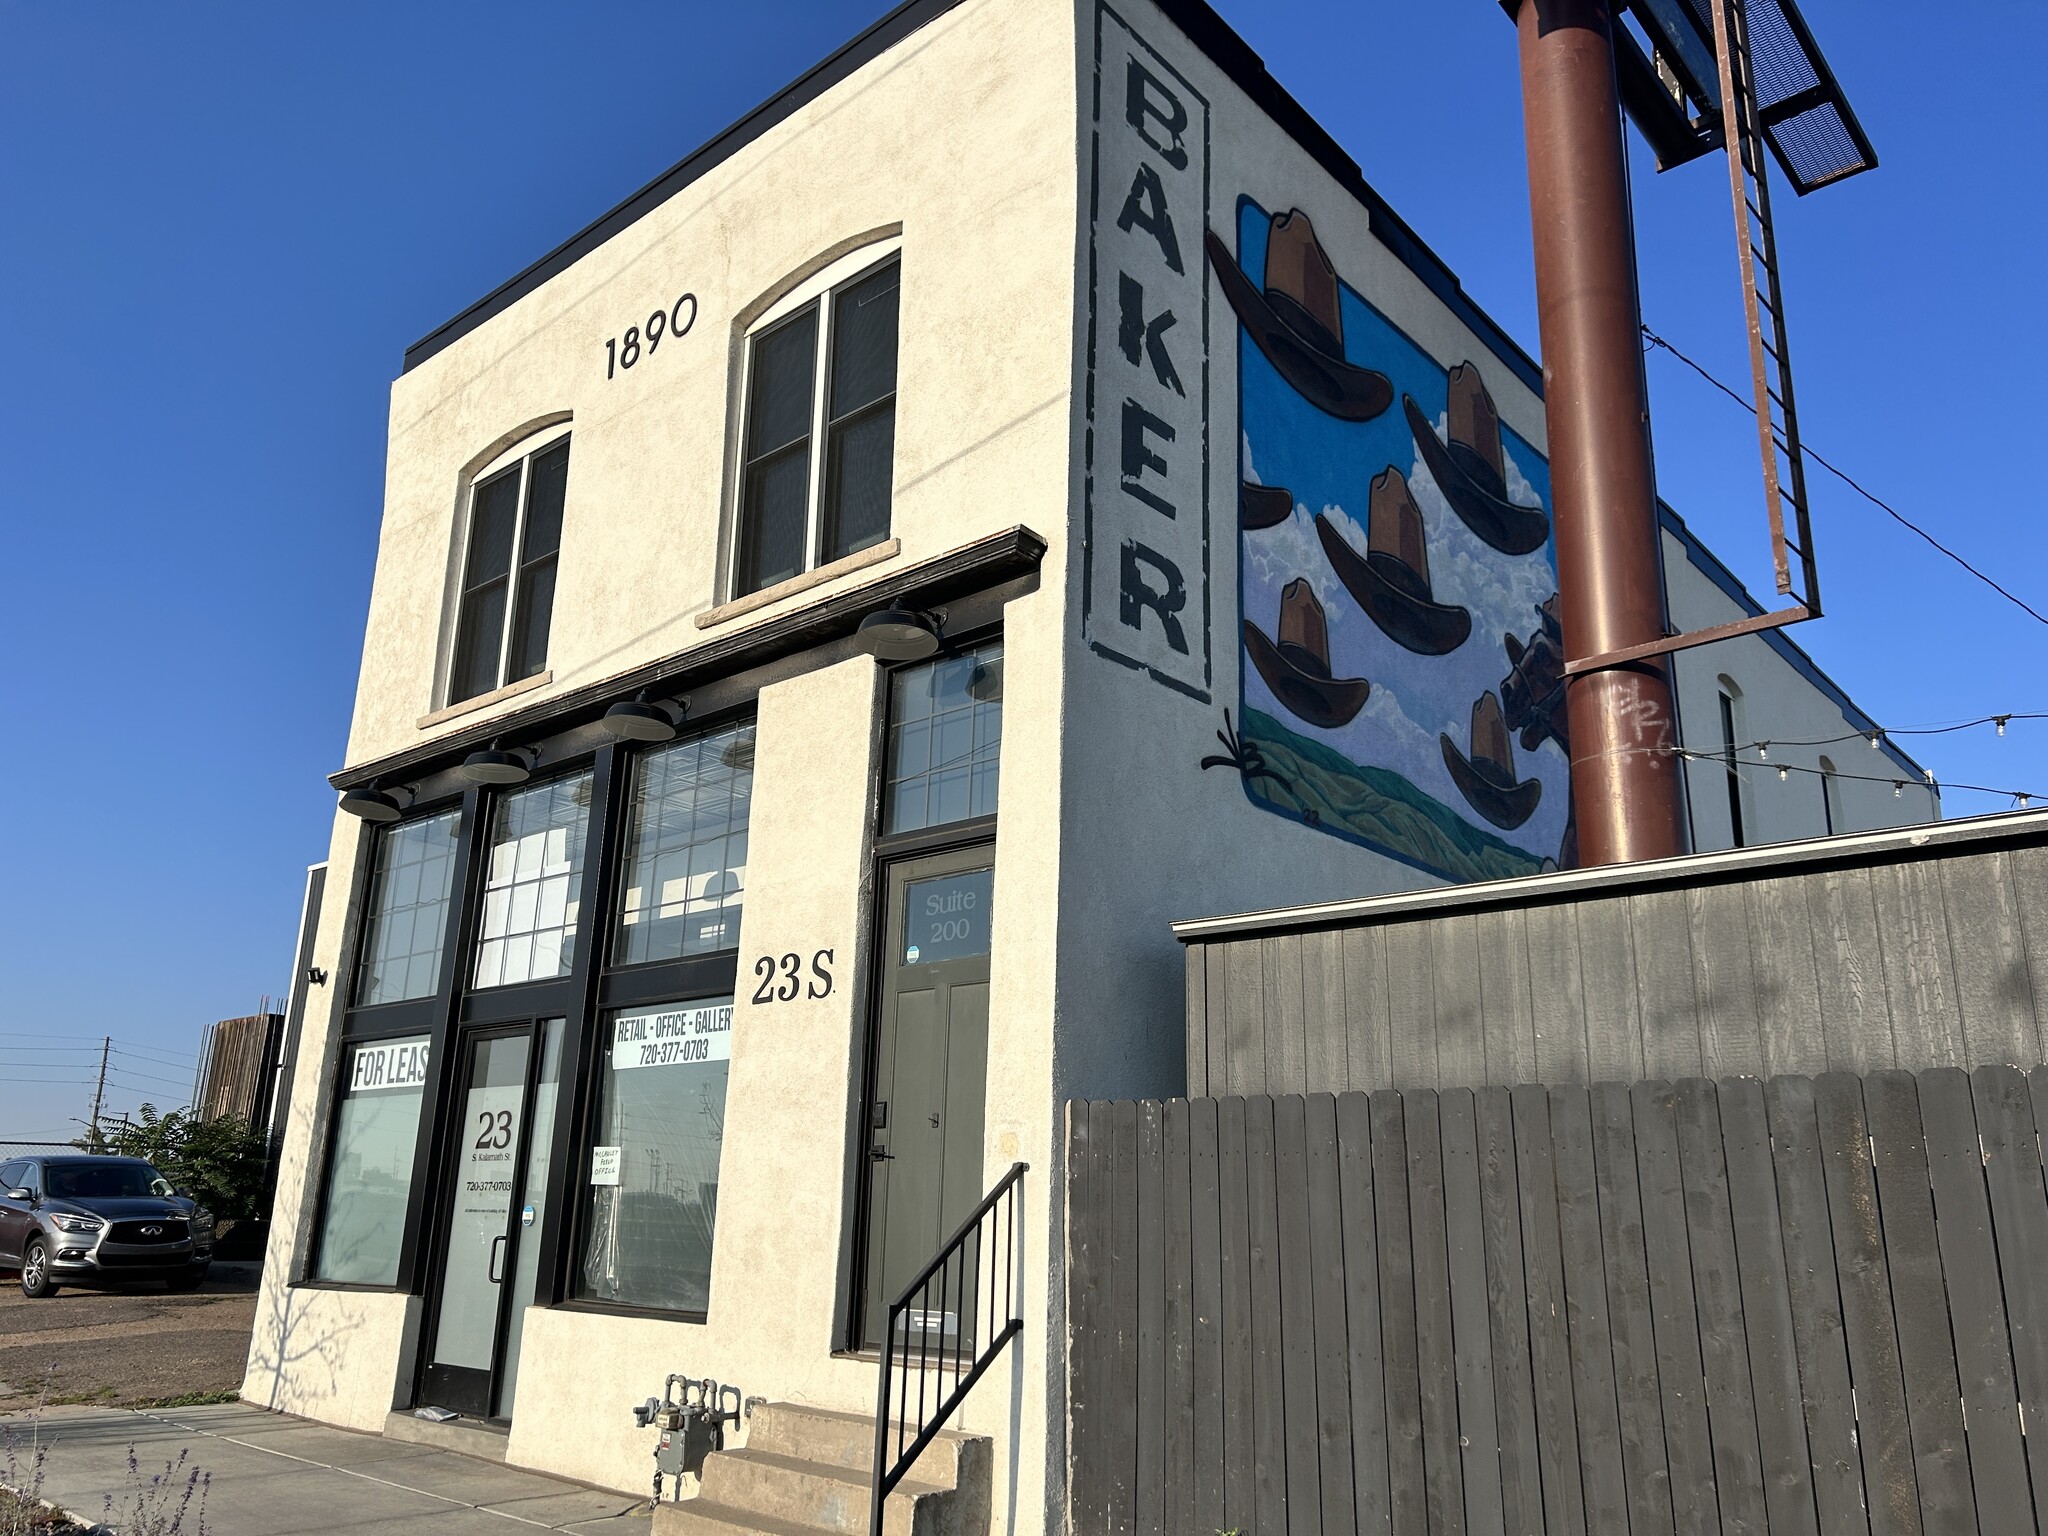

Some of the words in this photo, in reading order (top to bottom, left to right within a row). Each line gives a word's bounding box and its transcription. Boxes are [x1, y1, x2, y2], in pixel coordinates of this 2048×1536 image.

[605, 292, 698, 380] 1890
[1117, 51, 1189, 656] BAKER
[925, 890, 976, 916] Suite
[930, 918, 970, 943] 200
[751, 952, 801, 1005] 23
[807, 948, 837, 1000] S.
[617, 1018, 647, 1043] RETAIL
[655, 1012, 687, 1039] OFFICE
[353, 1049, 386, 1087] FOR
[639, 1038, 709, 1065] 720-377-0703
[475, 1110, 513, 1150] 23
[466, 1181, 512, 1192] 720-377-0703
